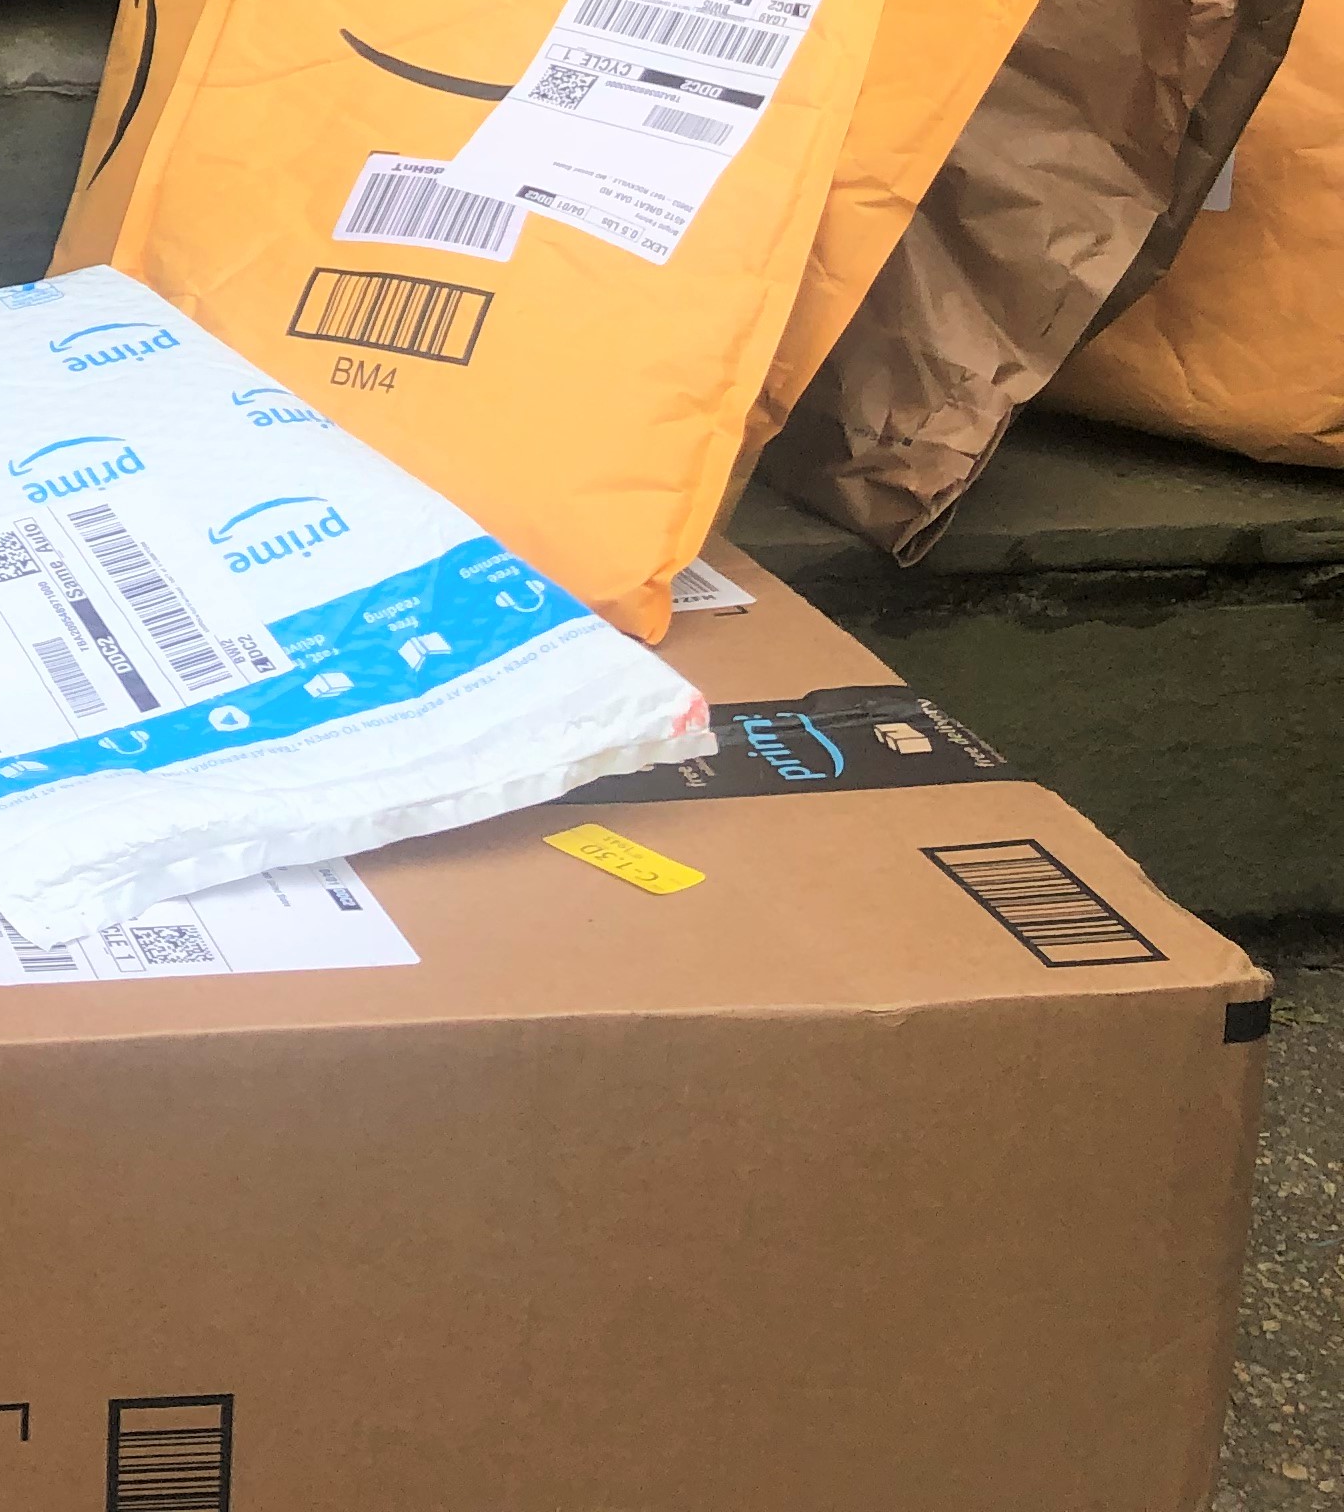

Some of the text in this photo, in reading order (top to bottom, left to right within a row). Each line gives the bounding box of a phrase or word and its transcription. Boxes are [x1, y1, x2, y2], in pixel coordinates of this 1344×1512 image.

[579, 54, 632, 78] CYCLE
[682, 79, 722, 99] DDC2
[640, 238, 670, 257] LEX2
[62, 329, 181, 372] prime
[330, 356, 398, 394] BM4
[22, 446, 146, 504] prime
[223, 506, 351, 574] prime
[24, 523, 84, 600] Same Auto
[487, 565, 520, 583] free
[363, 596, 421, 624] reading
[387, 615, 419, 632] free
[97, 635, 133, 674] DDC2
[220, 638, 246, 665] BWI2
[238, 633, 278, 674] ZDC2
[504, 641, 560, 673] TO OPEN
[579, 843, 660, 883] C-1.3D
